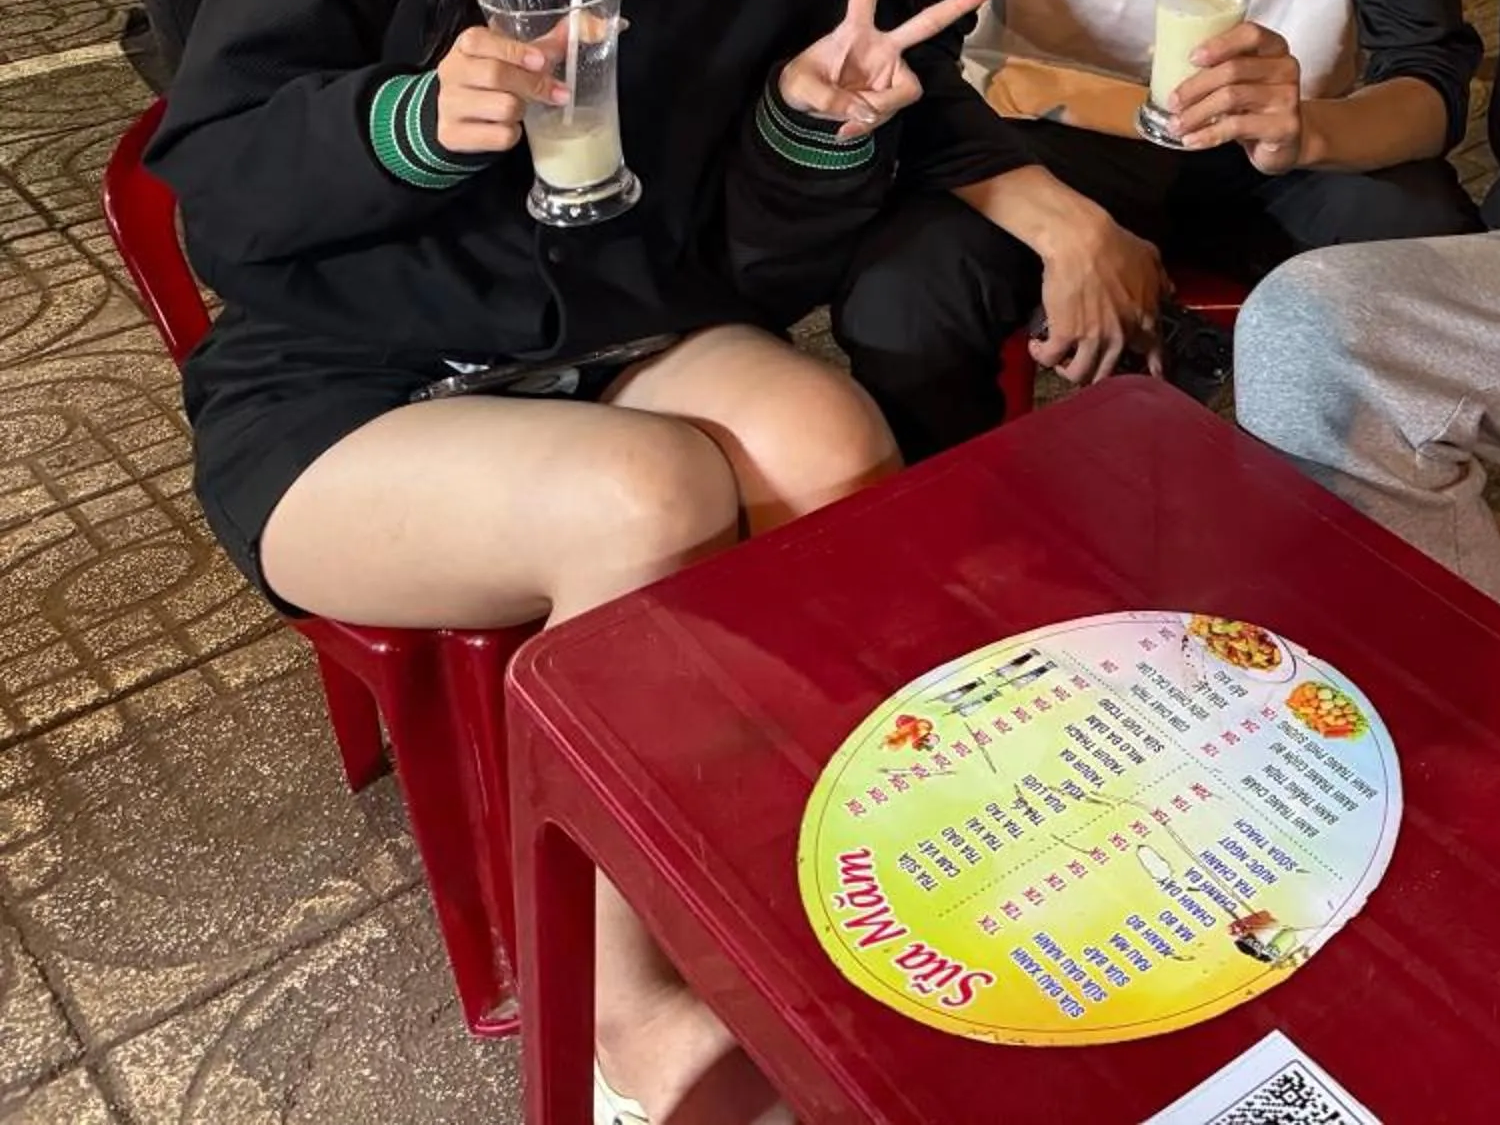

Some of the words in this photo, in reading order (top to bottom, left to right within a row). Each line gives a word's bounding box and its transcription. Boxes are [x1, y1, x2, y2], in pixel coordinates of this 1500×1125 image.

[1170, 794, 1191, 812] 15K
[1150, 807, 1171, 825] 15K
[1128, 819, 1151, 838] 15K
[1108, 832, 1130, 851] 15K
[1089, 846, 1109, 864] 15K
[1199, 849, 1236, 881] CHANH
[935, 855, 959, 877] CAM
[1066, 859, 1087, 878] 15K
[1045, 873, 1066, 892] 12K
[1023, 886, 1044, 906] 12K
[1199, 880, 1237, 913] CHANH
[1177, 893, 1216, 927] CHANH
[1010, 947, 1042, 976] XANH
[1125, 948, 1151, 972] RAU
[896, 944, 992, 1005] Sữa
